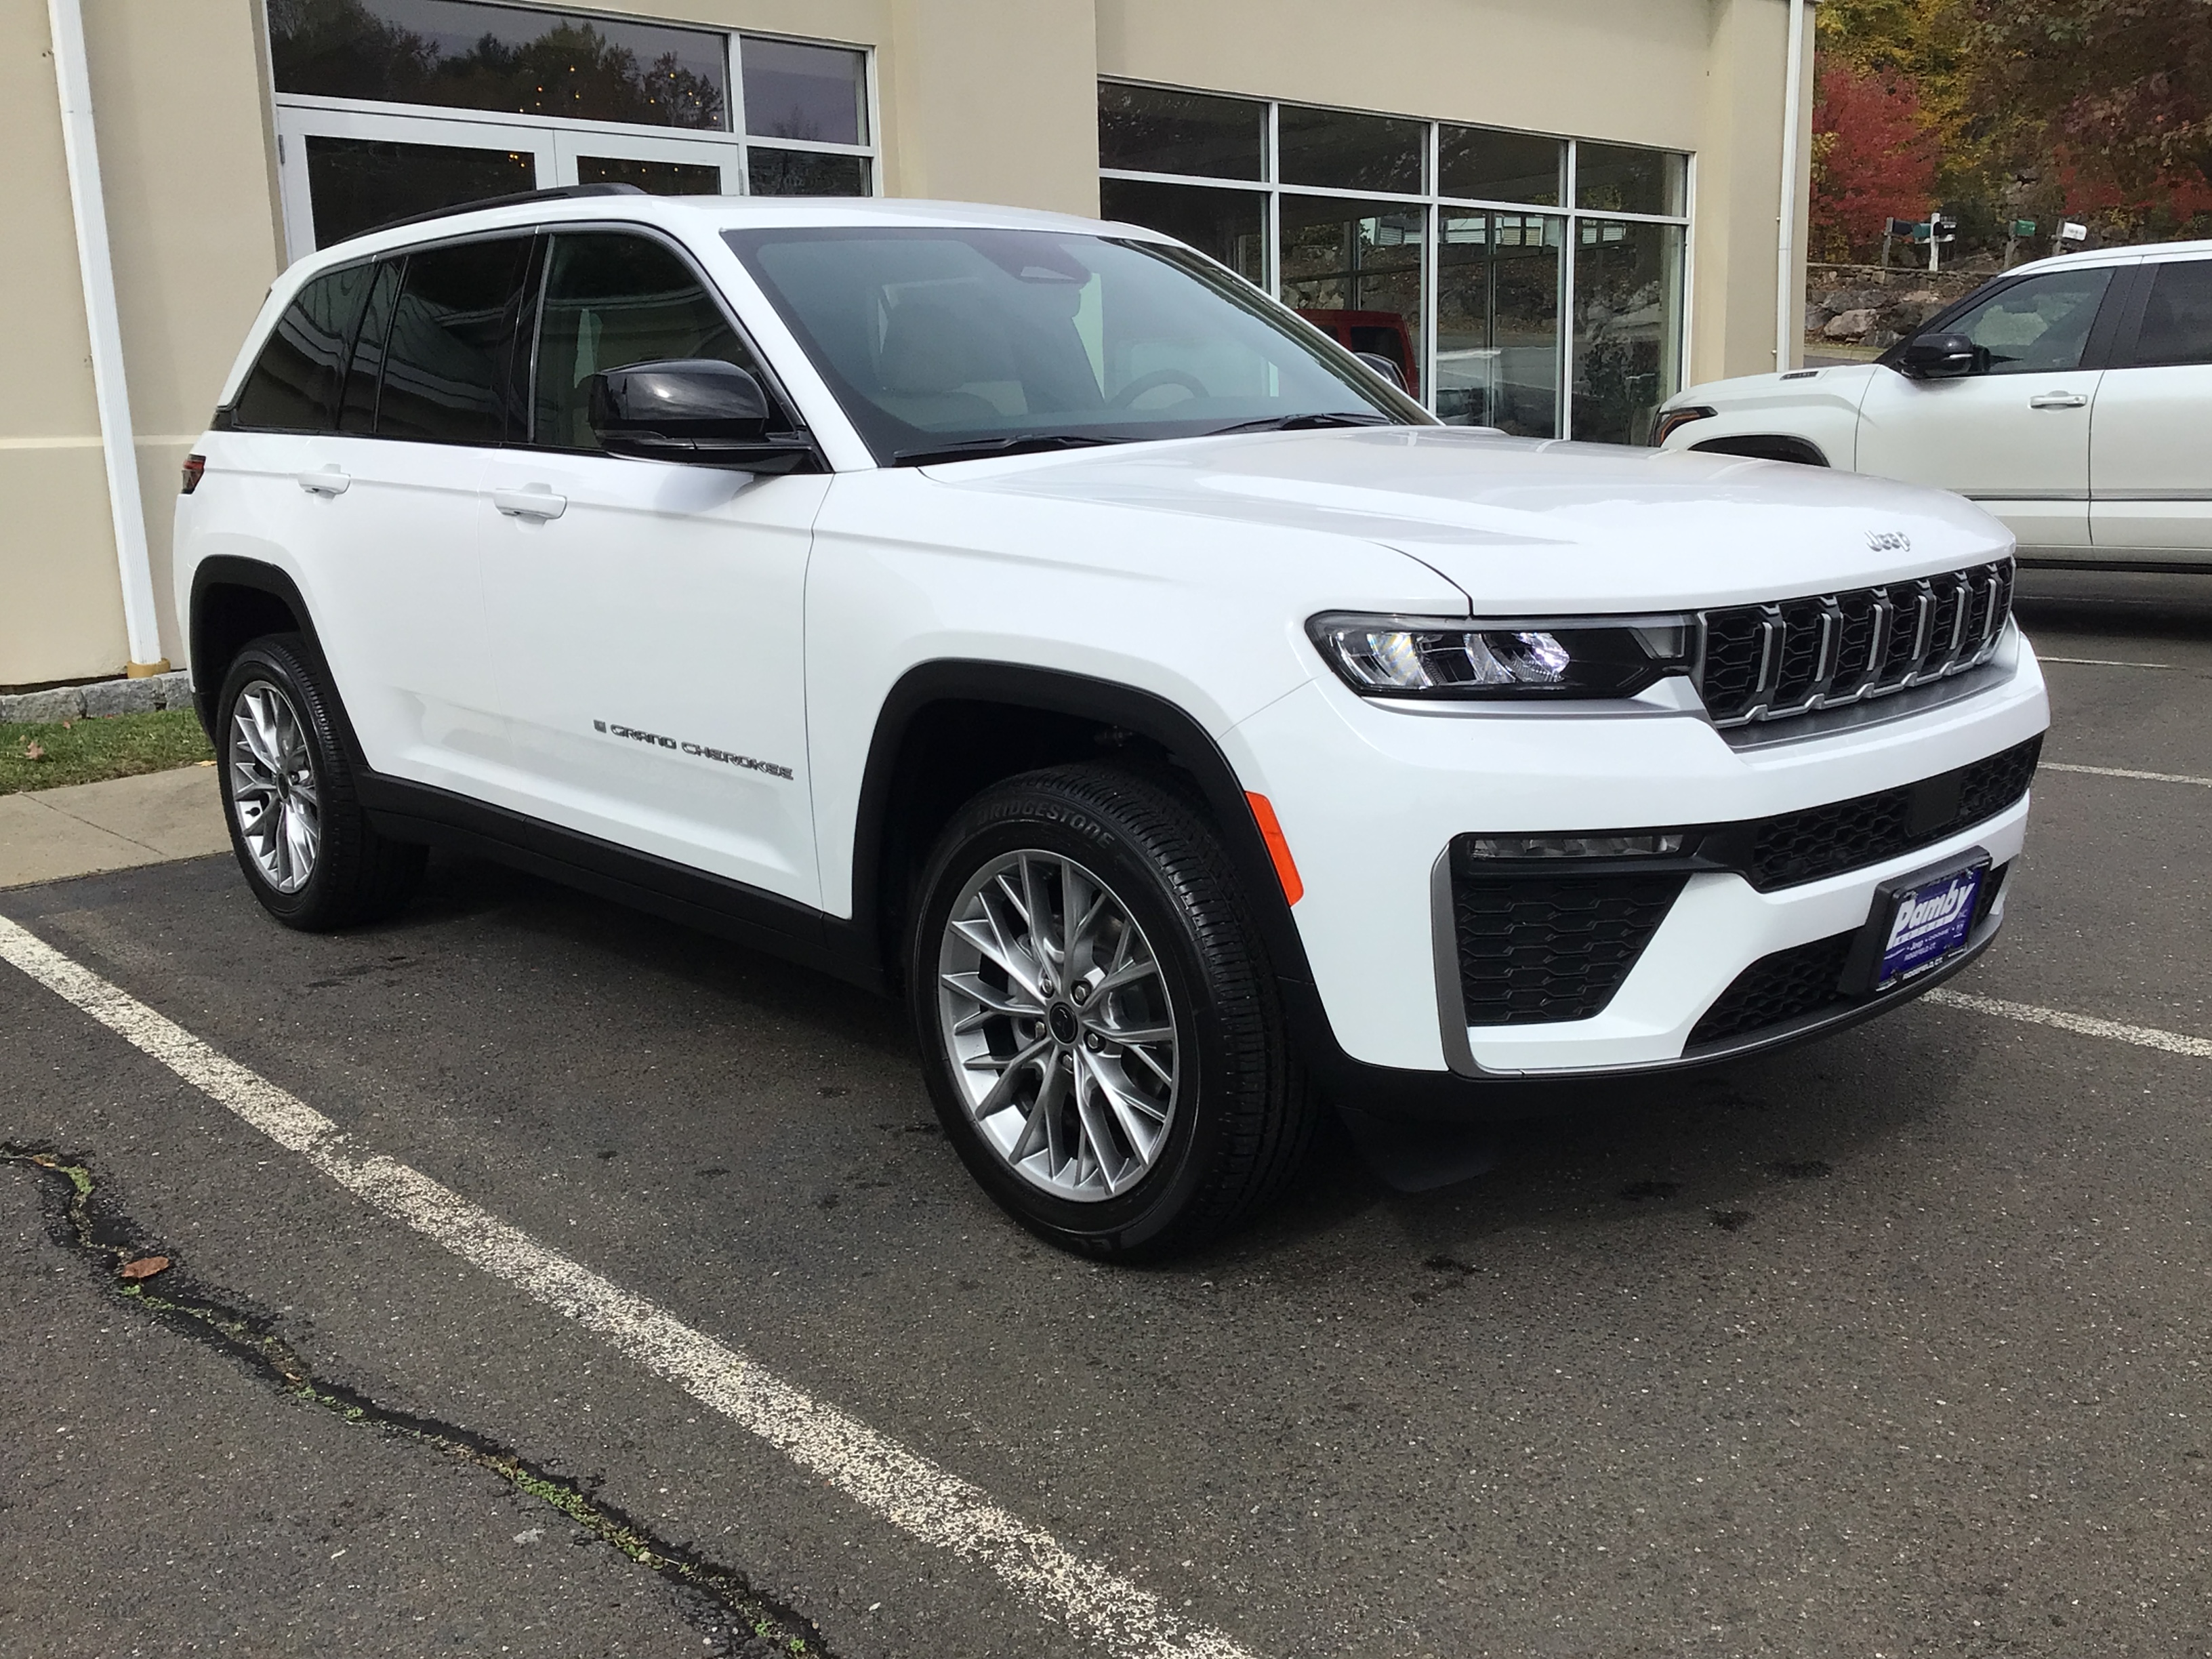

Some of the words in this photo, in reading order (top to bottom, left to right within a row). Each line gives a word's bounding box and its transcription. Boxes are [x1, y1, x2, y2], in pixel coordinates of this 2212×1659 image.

[1864, 530, 1910, 552] Jeep
[610, 723, 678, 750] GRAND
[680, 741, 794, 781] CHEROKEE
[1885, 879, 1976, 951] Pamby
